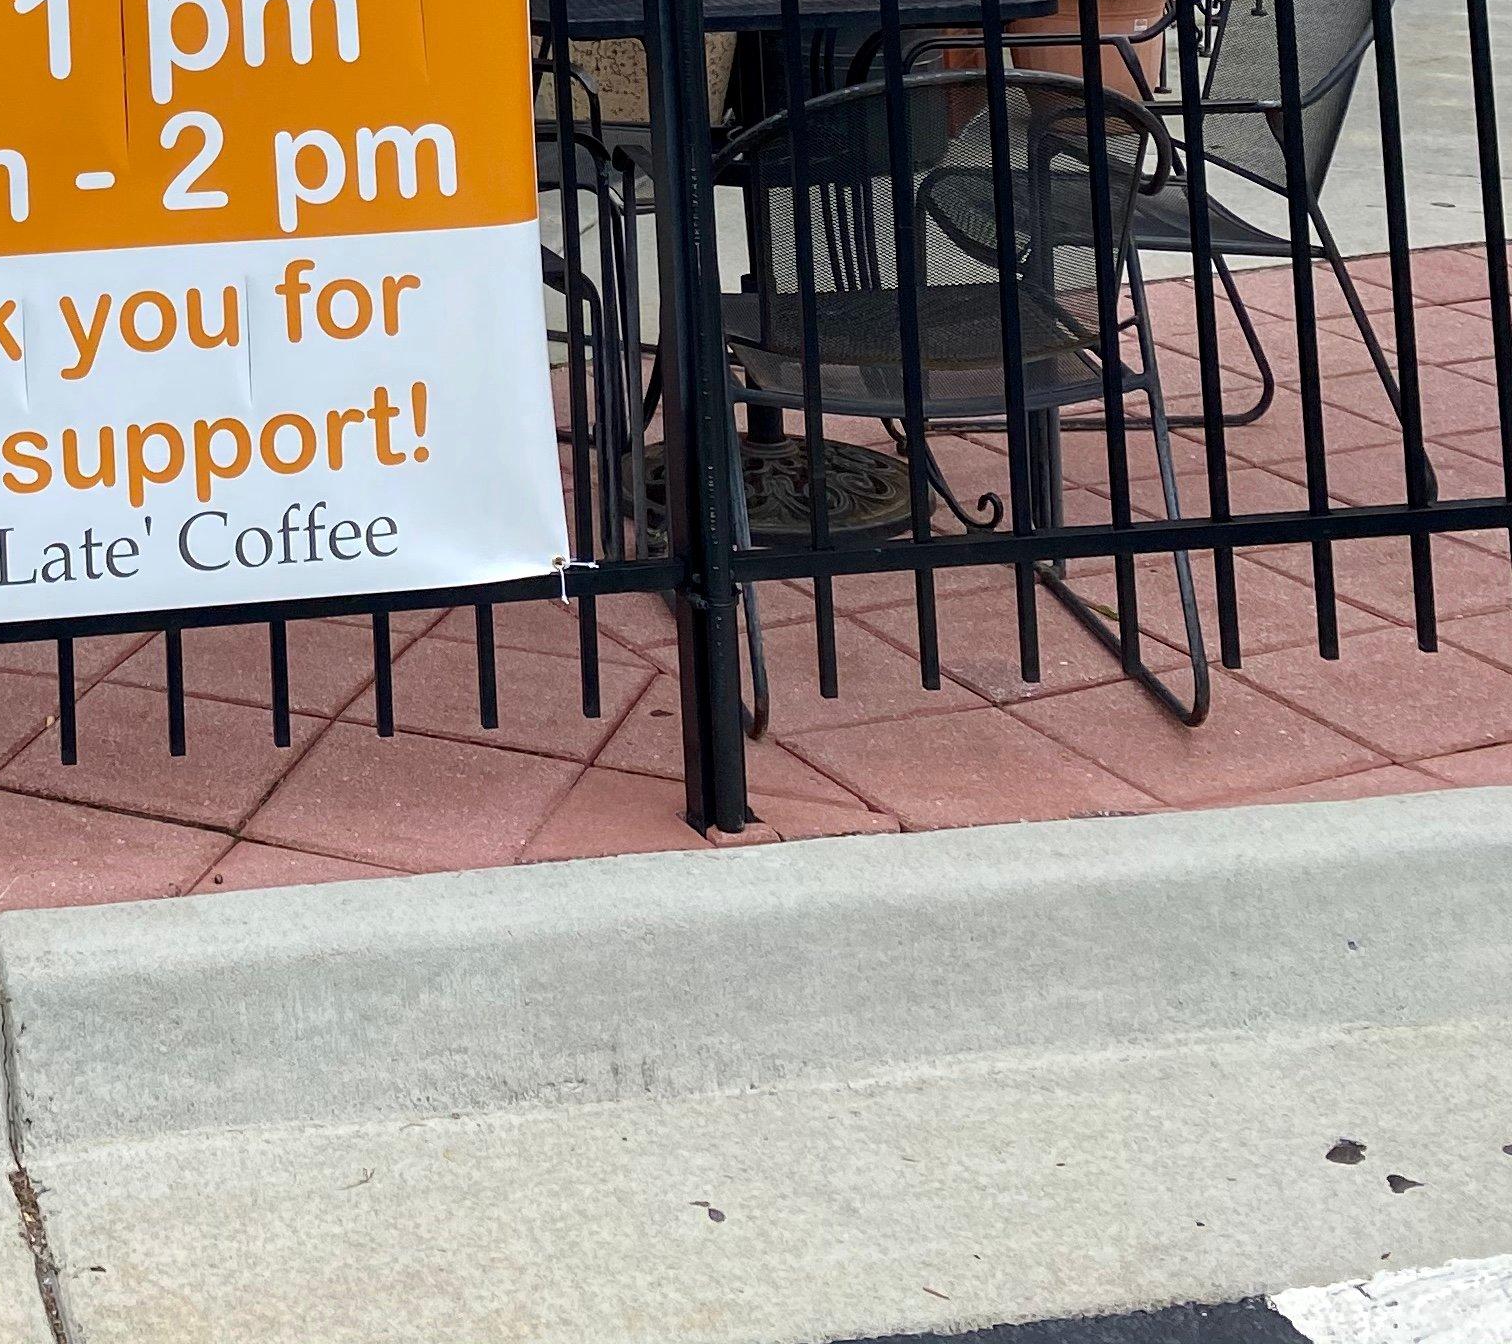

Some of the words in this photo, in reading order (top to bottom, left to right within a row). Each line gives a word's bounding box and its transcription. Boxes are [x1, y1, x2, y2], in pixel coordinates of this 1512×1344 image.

[74, 170, 116, 191] -
[158, 110, 230, 212] 2
[273, 122, 459, 234] pm
[58, 284, 239, 382] you
[274, 258, 423, 345] for
[0, 379, 431, 509] support!
[178, 500, 401, 571] Coffee
